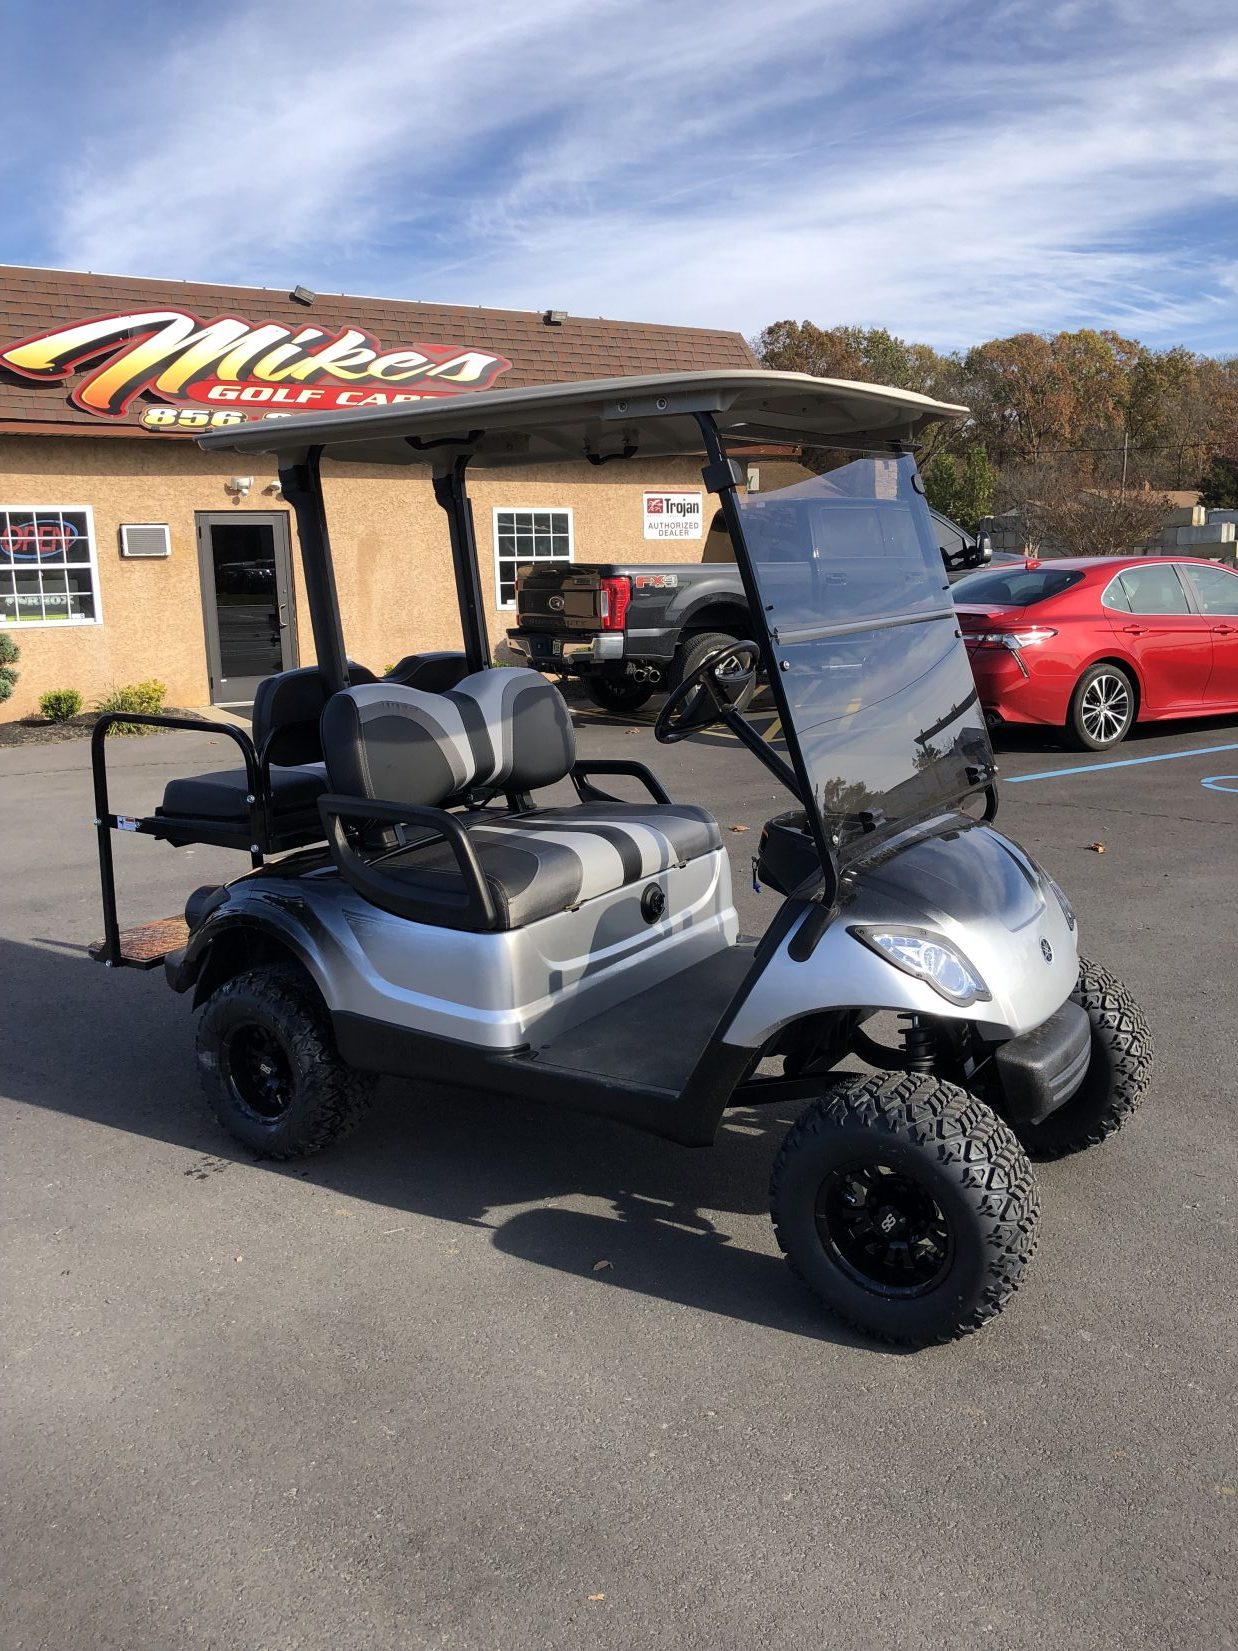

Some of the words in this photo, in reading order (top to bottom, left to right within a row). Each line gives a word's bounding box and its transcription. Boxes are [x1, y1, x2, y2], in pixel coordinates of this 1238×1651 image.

[207, 385, 325, 403] GOLF
[664, 498, 700, 517] Trojan
[648, 522, 699, 530] AUTHORIZED
[3, 526, 71, 552] OPEN
[636, 575, 678, 588] FX4
